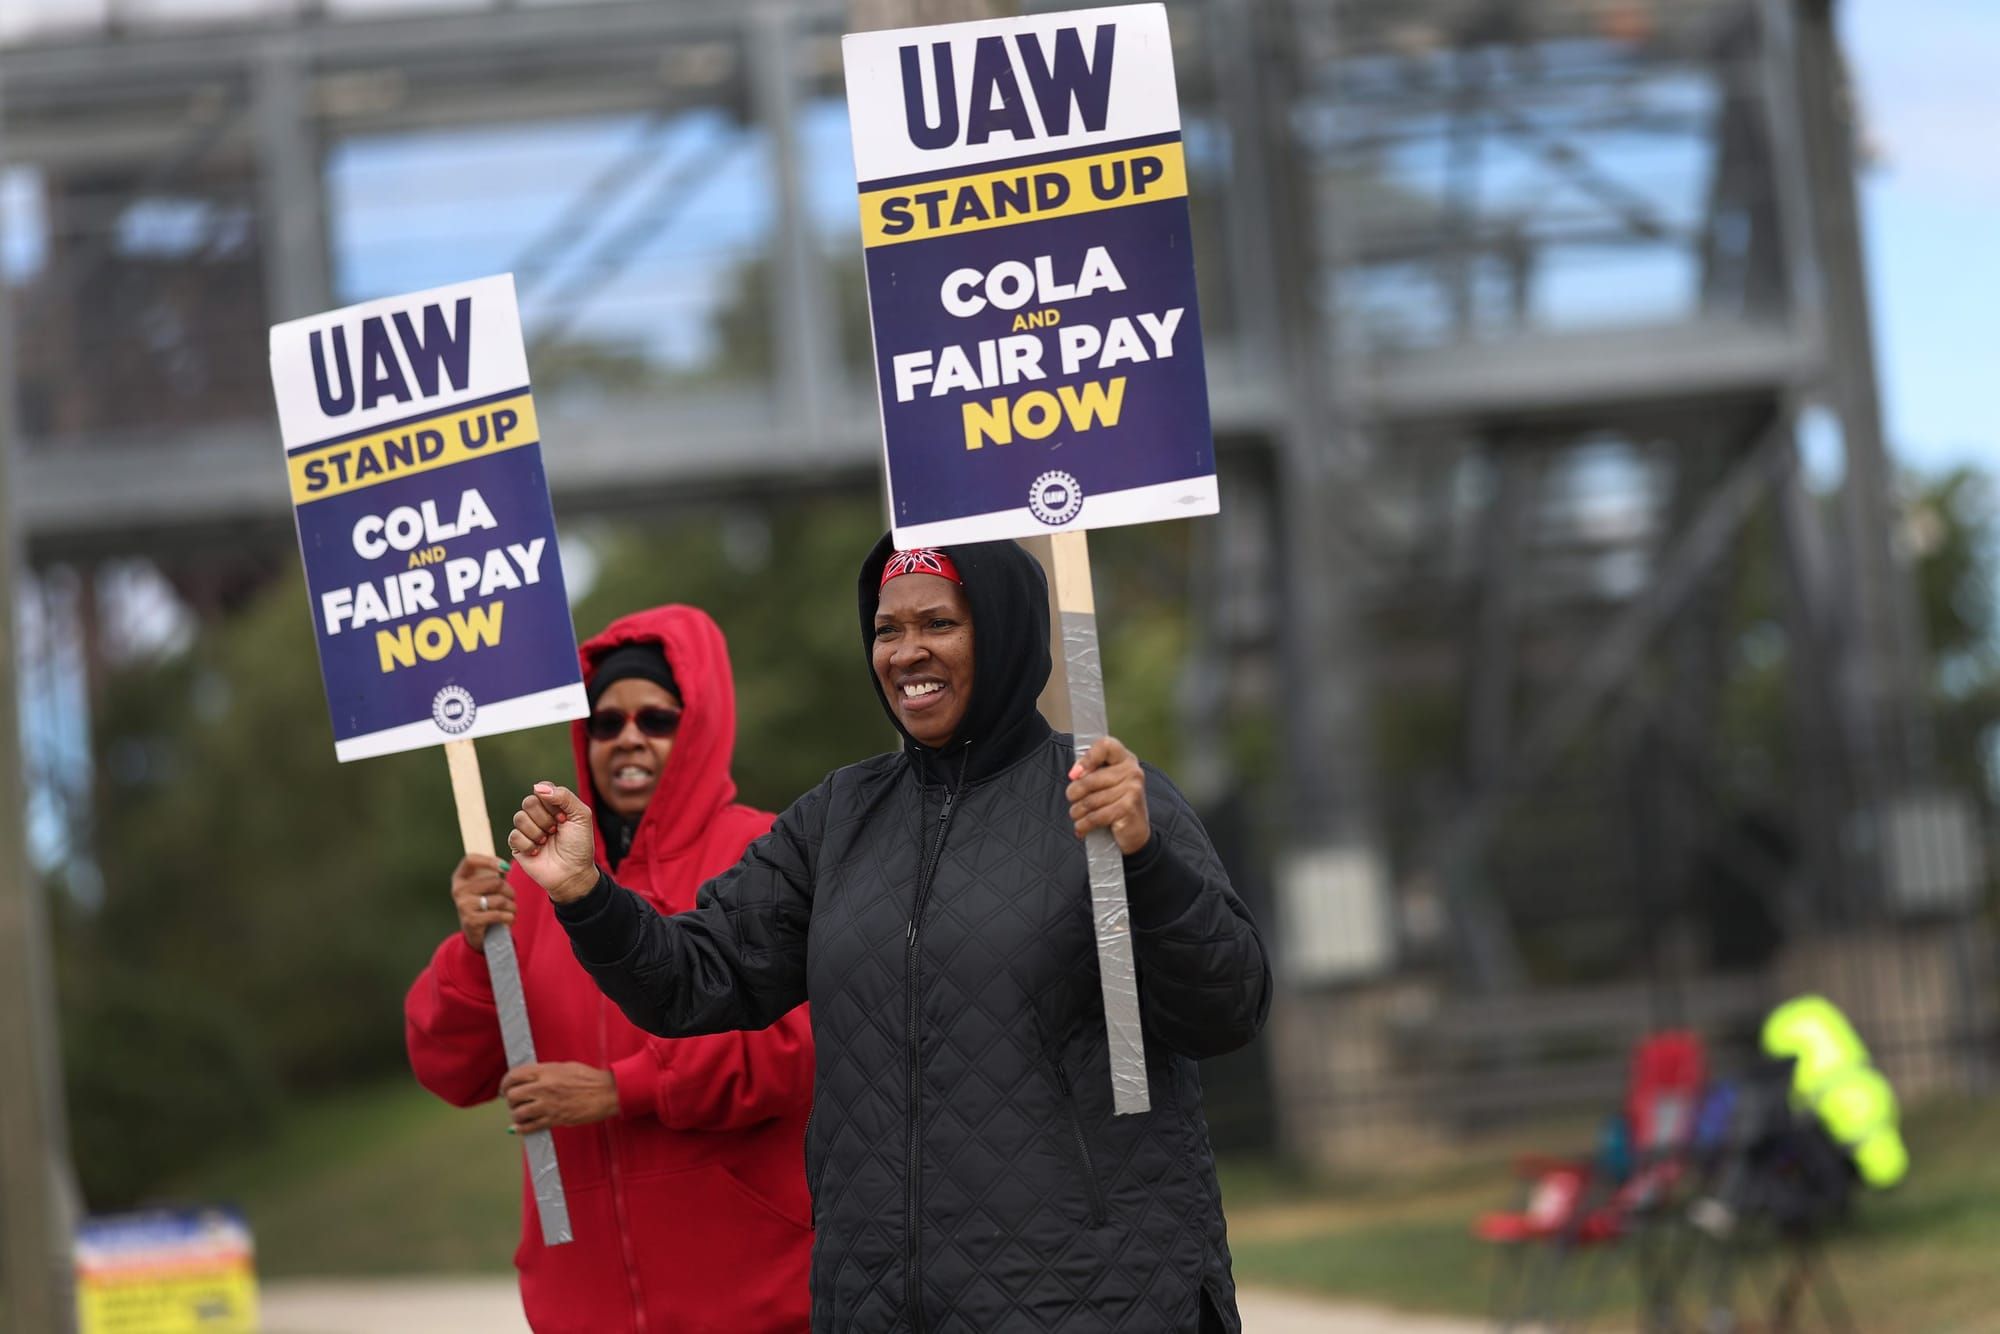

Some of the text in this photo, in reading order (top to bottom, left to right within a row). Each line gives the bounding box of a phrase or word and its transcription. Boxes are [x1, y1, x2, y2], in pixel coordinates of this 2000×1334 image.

[899, 23, 1117, 151] UAW
[880, 156, 1164, 236] STAND UP
[940, 246, 1127, 318] COLA
[1012, 308, 1061, 332] AND
[309, 297, 472, 418] UAW
[892, 307, 1185, 402] FAIR PAY
[304, 408, 518, 493] STAND UP
[961, 376, 1127, 451] NOW
[352, 488, 498, 561] COLA
[407, 545, 447, 571] AND
[322, 537, 547, 635] FAIR PAY
[375, 601, 504, 674] NOW
